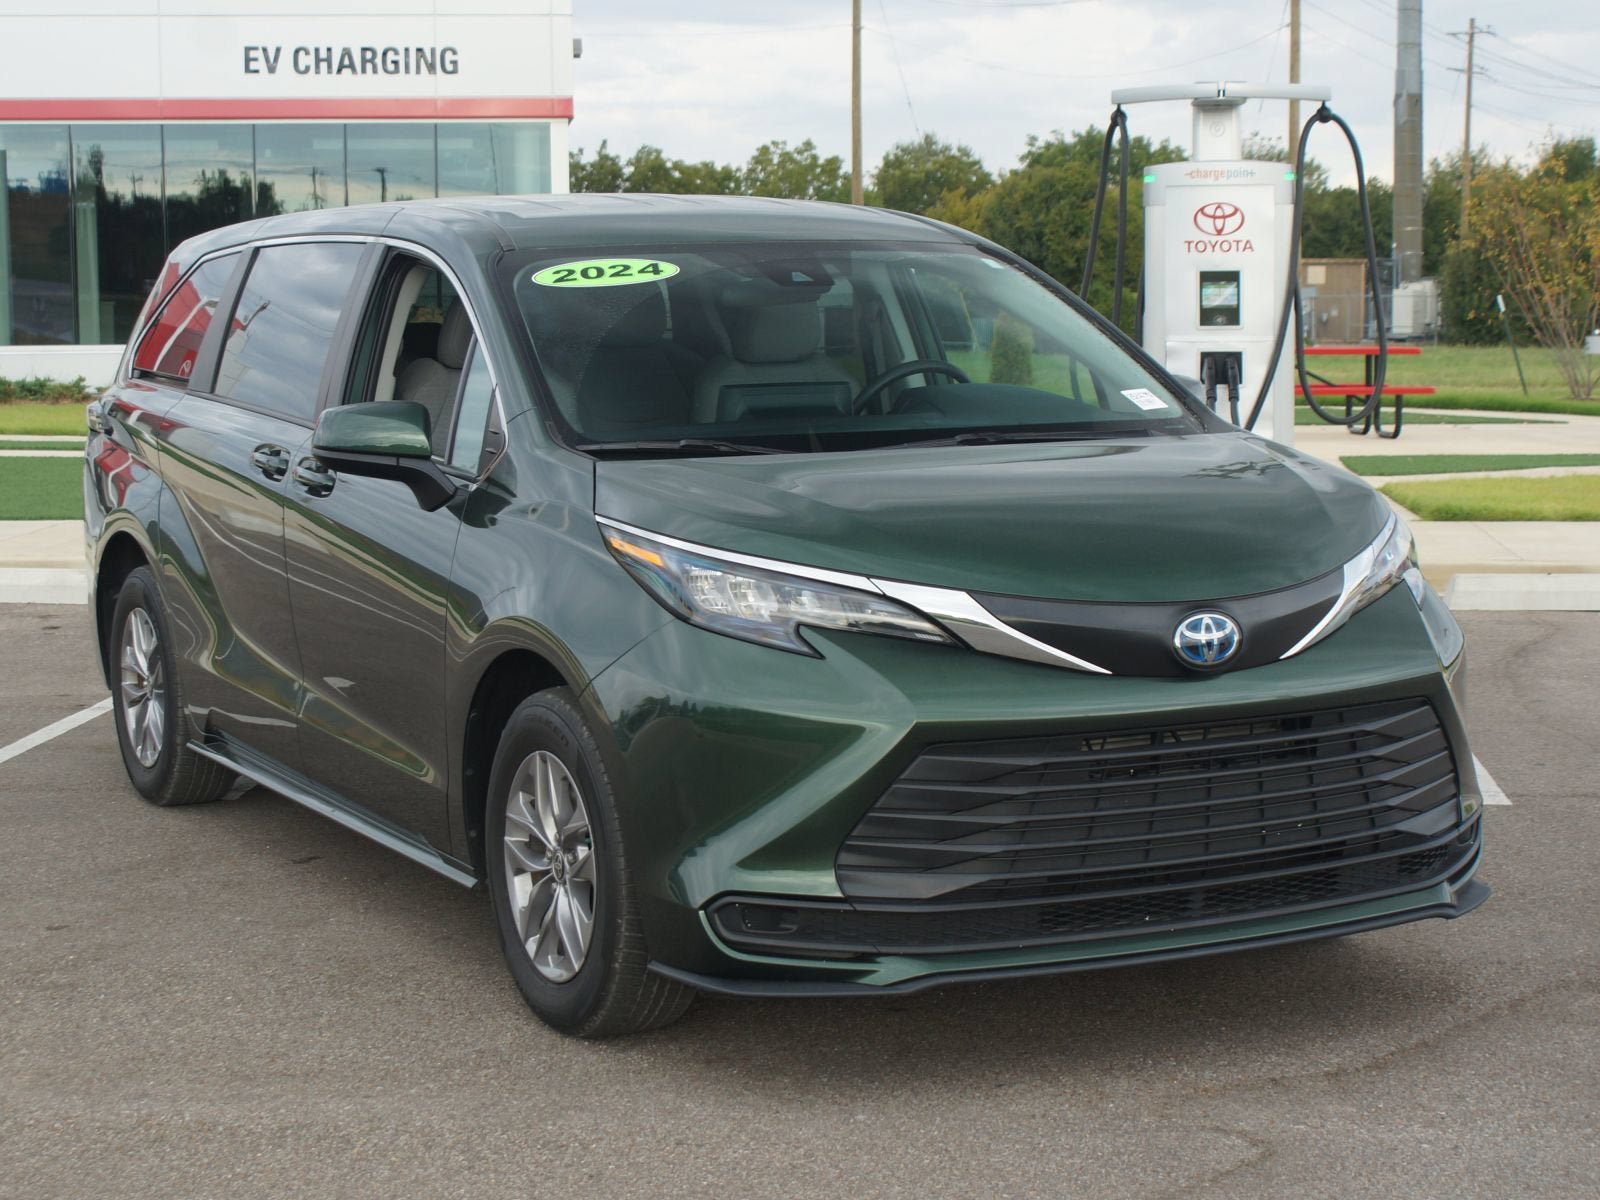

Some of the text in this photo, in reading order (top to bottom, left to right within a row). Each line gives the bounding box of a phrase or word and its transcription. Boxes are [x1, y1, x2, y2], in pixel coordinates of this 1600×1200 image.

[244, 46, 459, 75] EV CHARGING
[1184, 239, 1254, 254] TOYOTA
[552, 263, 663, 284] 2024
